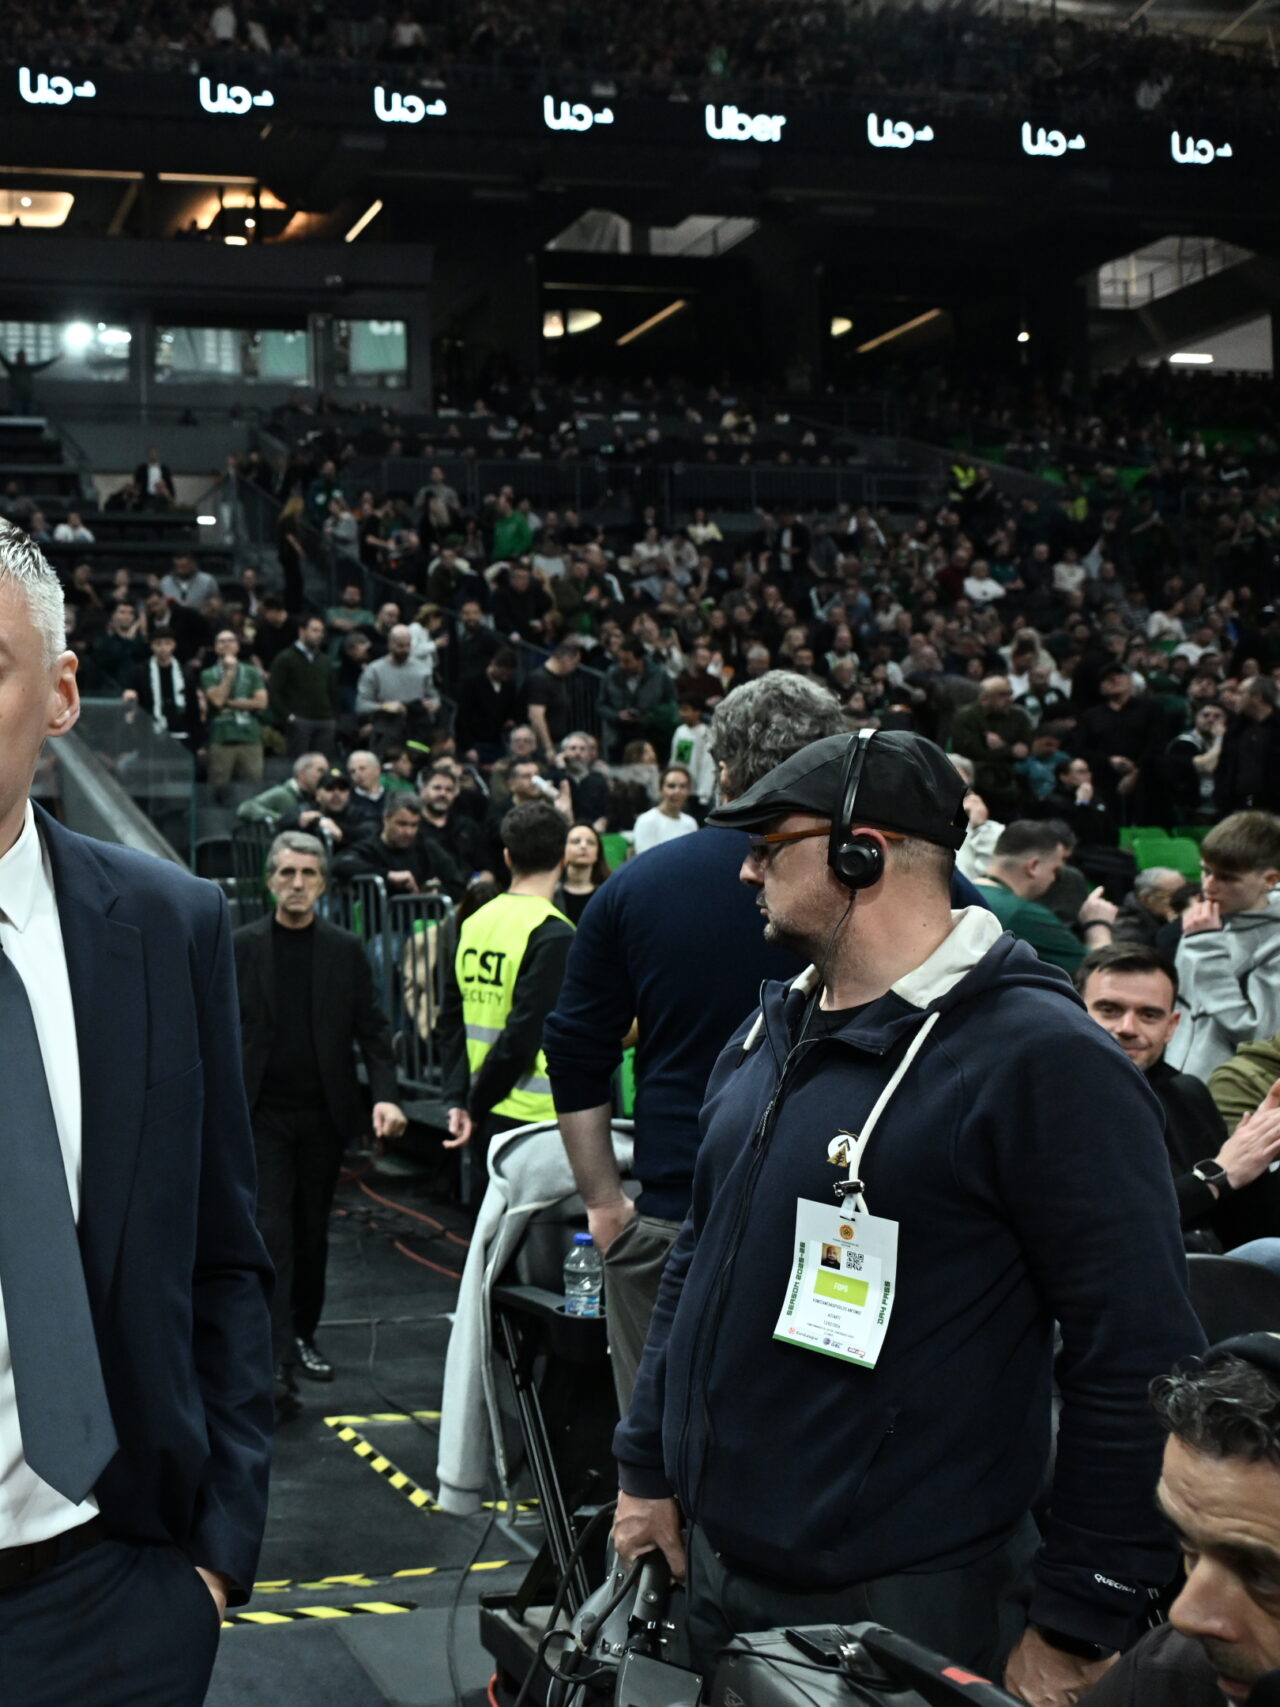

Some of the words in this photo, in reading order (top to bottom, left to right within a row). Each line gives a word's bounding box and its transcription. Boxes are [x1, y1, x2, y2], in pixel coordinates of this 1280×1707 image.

[706, 104, 786, 142] Uber
[786, 1281, 800, 1316] SEASON
[877, 1306, 887, 1325] DAY
[882, 1280, 891, 1305] PASS
